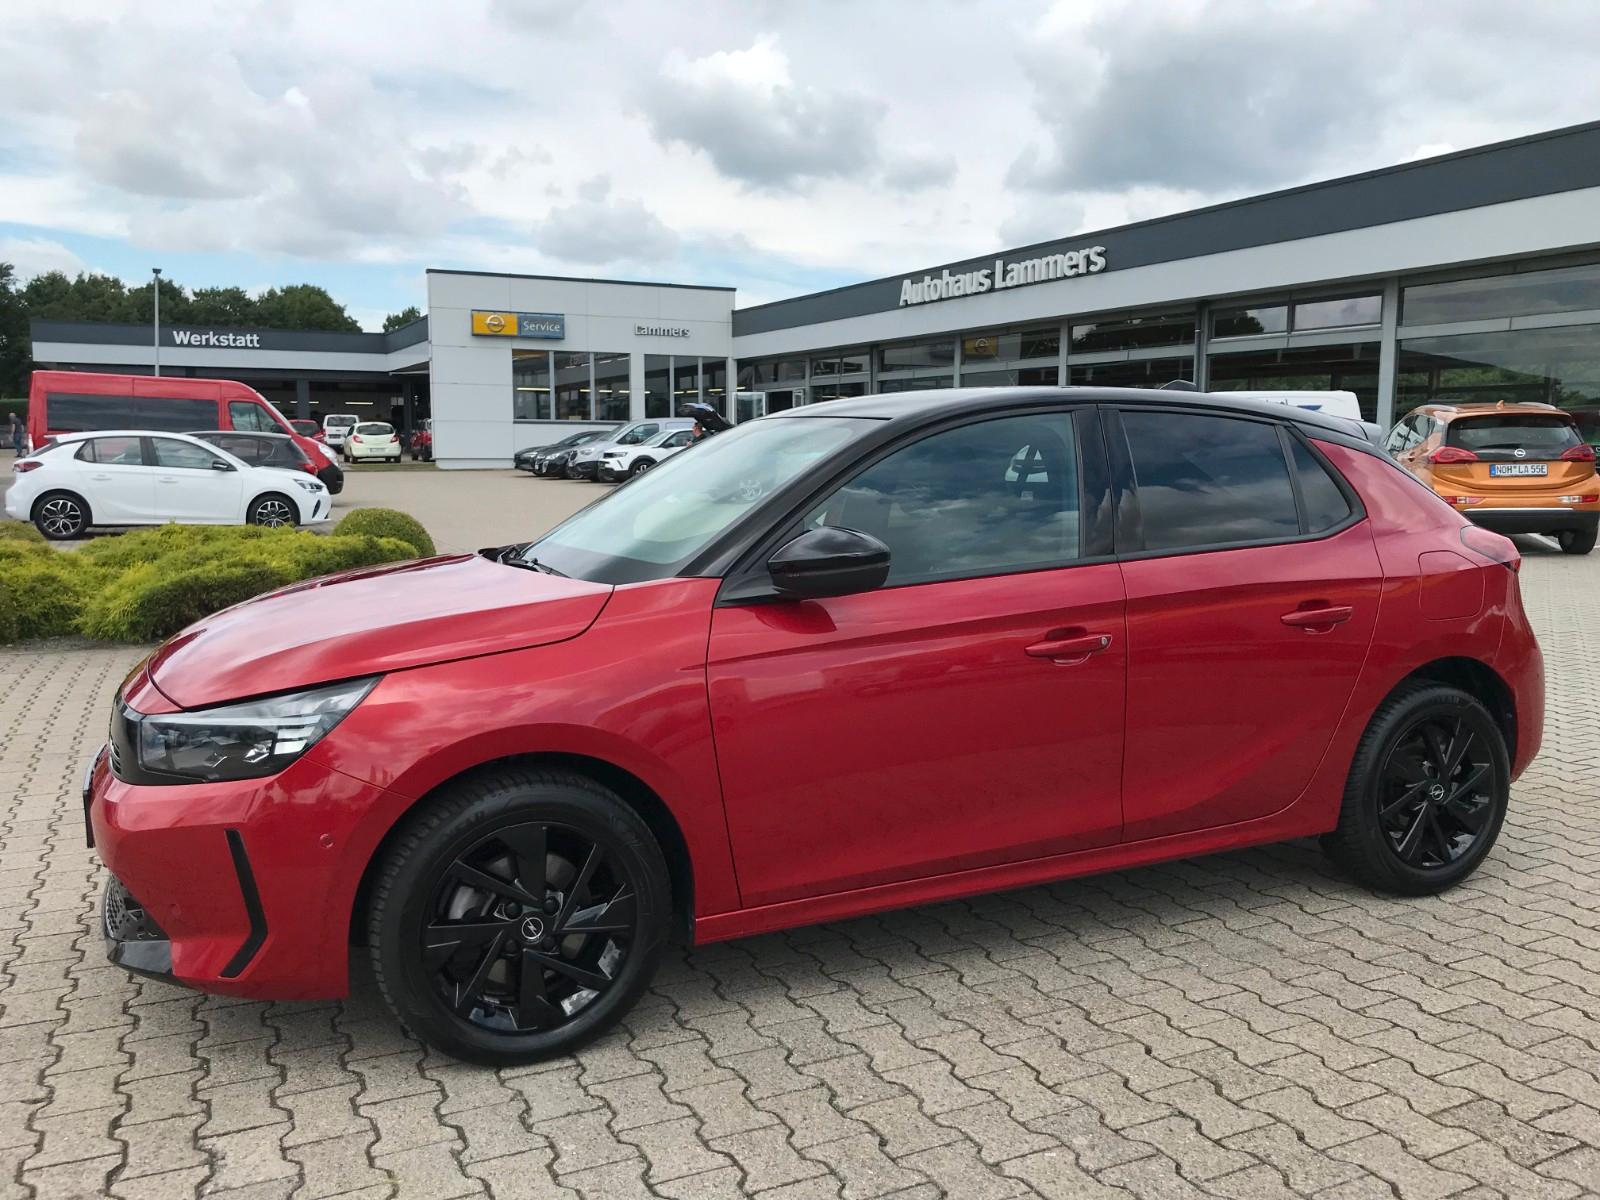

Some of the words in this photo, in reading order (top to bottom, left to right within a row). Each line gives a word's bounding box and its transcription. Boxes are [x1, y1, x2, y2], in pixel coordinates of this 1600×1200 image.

[899, 268, 992, 306] Autohaus
[994, 245, 1107, 289] Lammers
[523, 321, 561, 333] Service
[635, 323, 691, 338] Lammers
[172, 330, 261, 348] Werkstatt
[1496, 465, 1513, 474] NOH
[1518, 465, 1529, 474] LA
[1531, 464, 1546, 474] 55E
